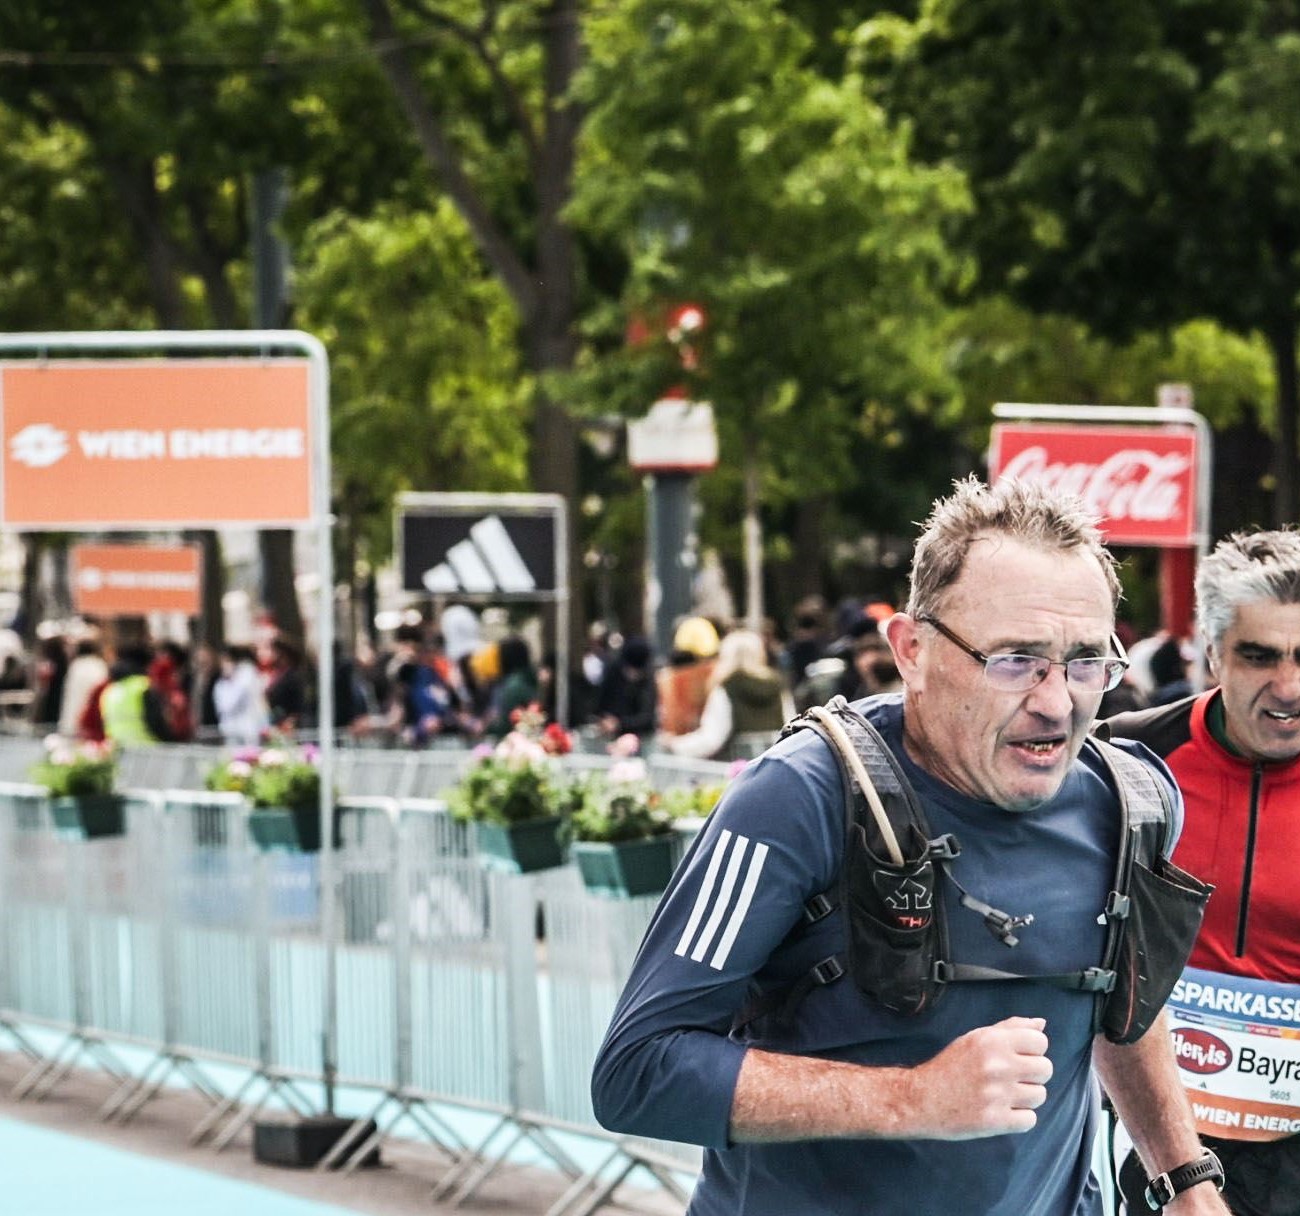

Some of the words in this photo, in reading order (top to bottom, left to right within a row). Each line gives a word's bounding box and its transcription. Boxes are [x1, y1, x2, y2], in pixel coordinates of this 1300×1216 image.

[78, 429, 165, 459] WIEN
[170, 428, 304, 458] ENERGIE
[1171, 1032, 1227, 1067] Hervis
[1192, 1102, 1241, 1128] WIEN
